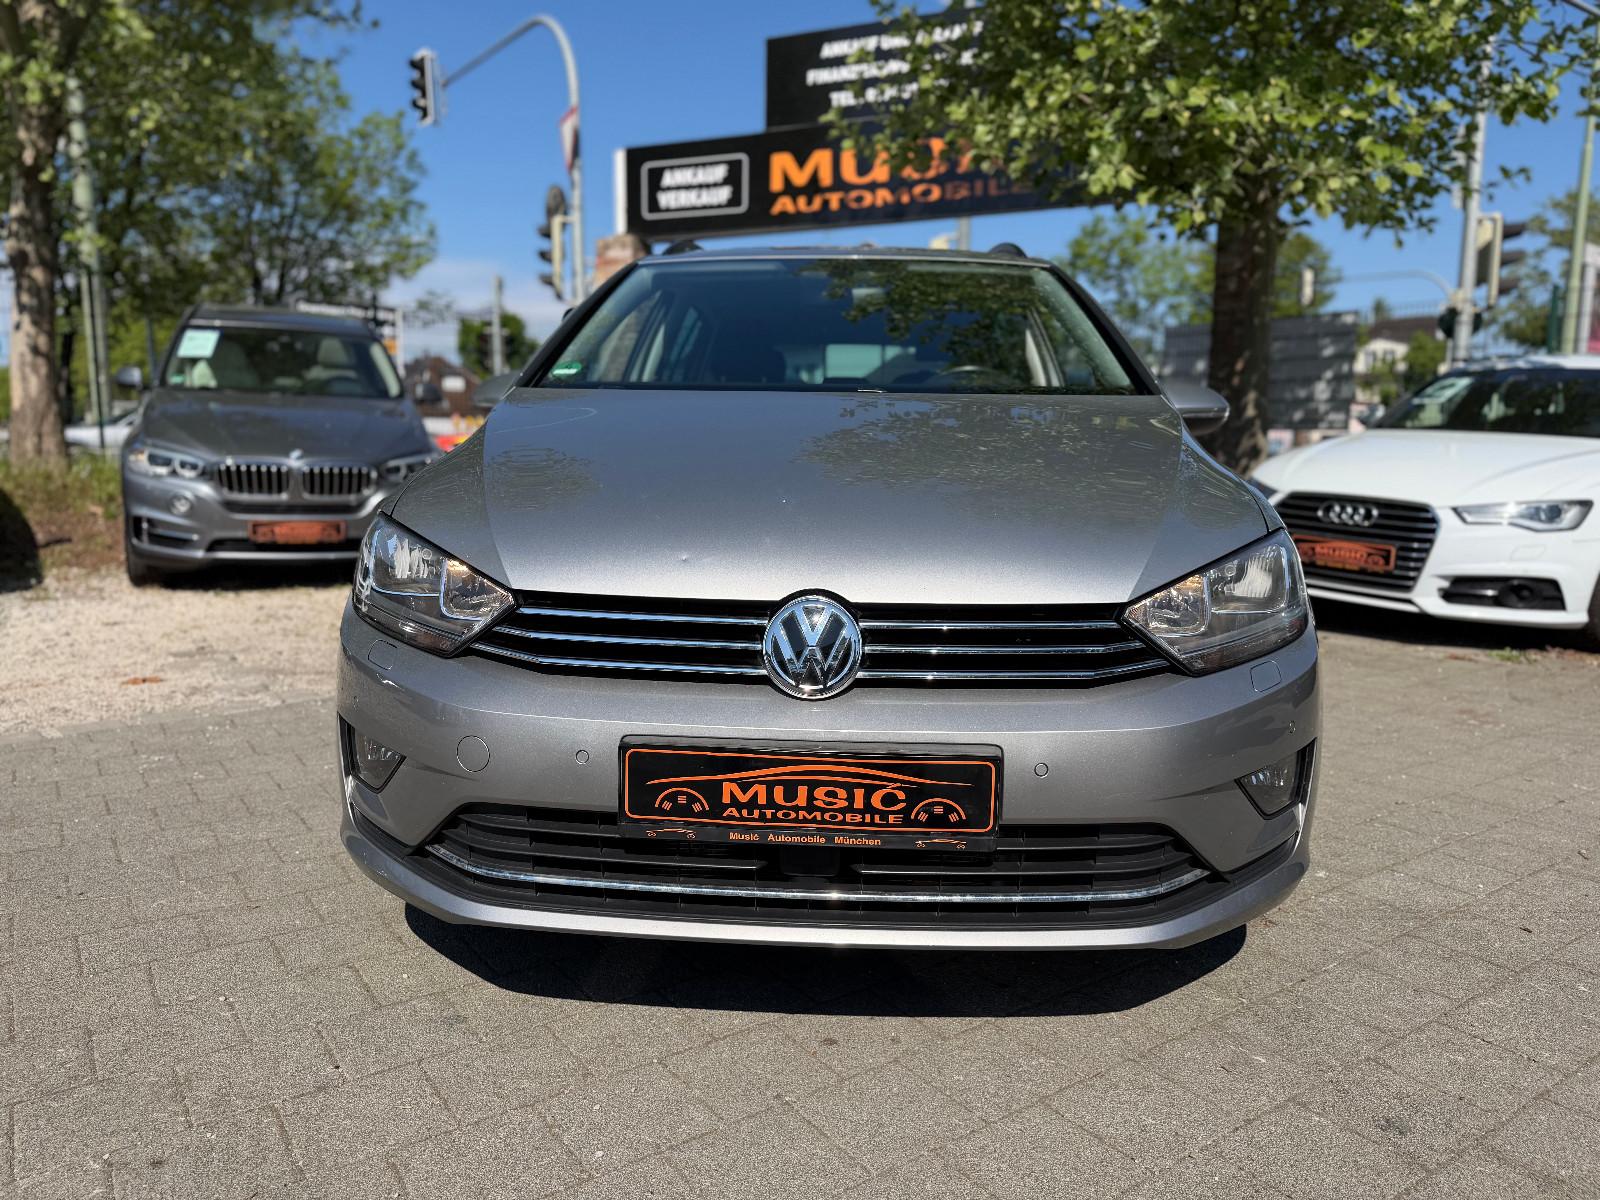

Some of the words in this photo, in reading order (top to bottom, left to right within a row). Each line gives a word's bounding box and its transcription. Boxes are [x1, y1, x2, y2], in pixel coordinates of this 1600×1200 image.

[660, 163, 729, 188] ANKAUF
[656, 185, 733, 210] VERKAUF
[722, 807, 904, 824] AUTOMOBILE
[767, 833, 826, 844] Automobile
[834, 835, 881, 846] München
